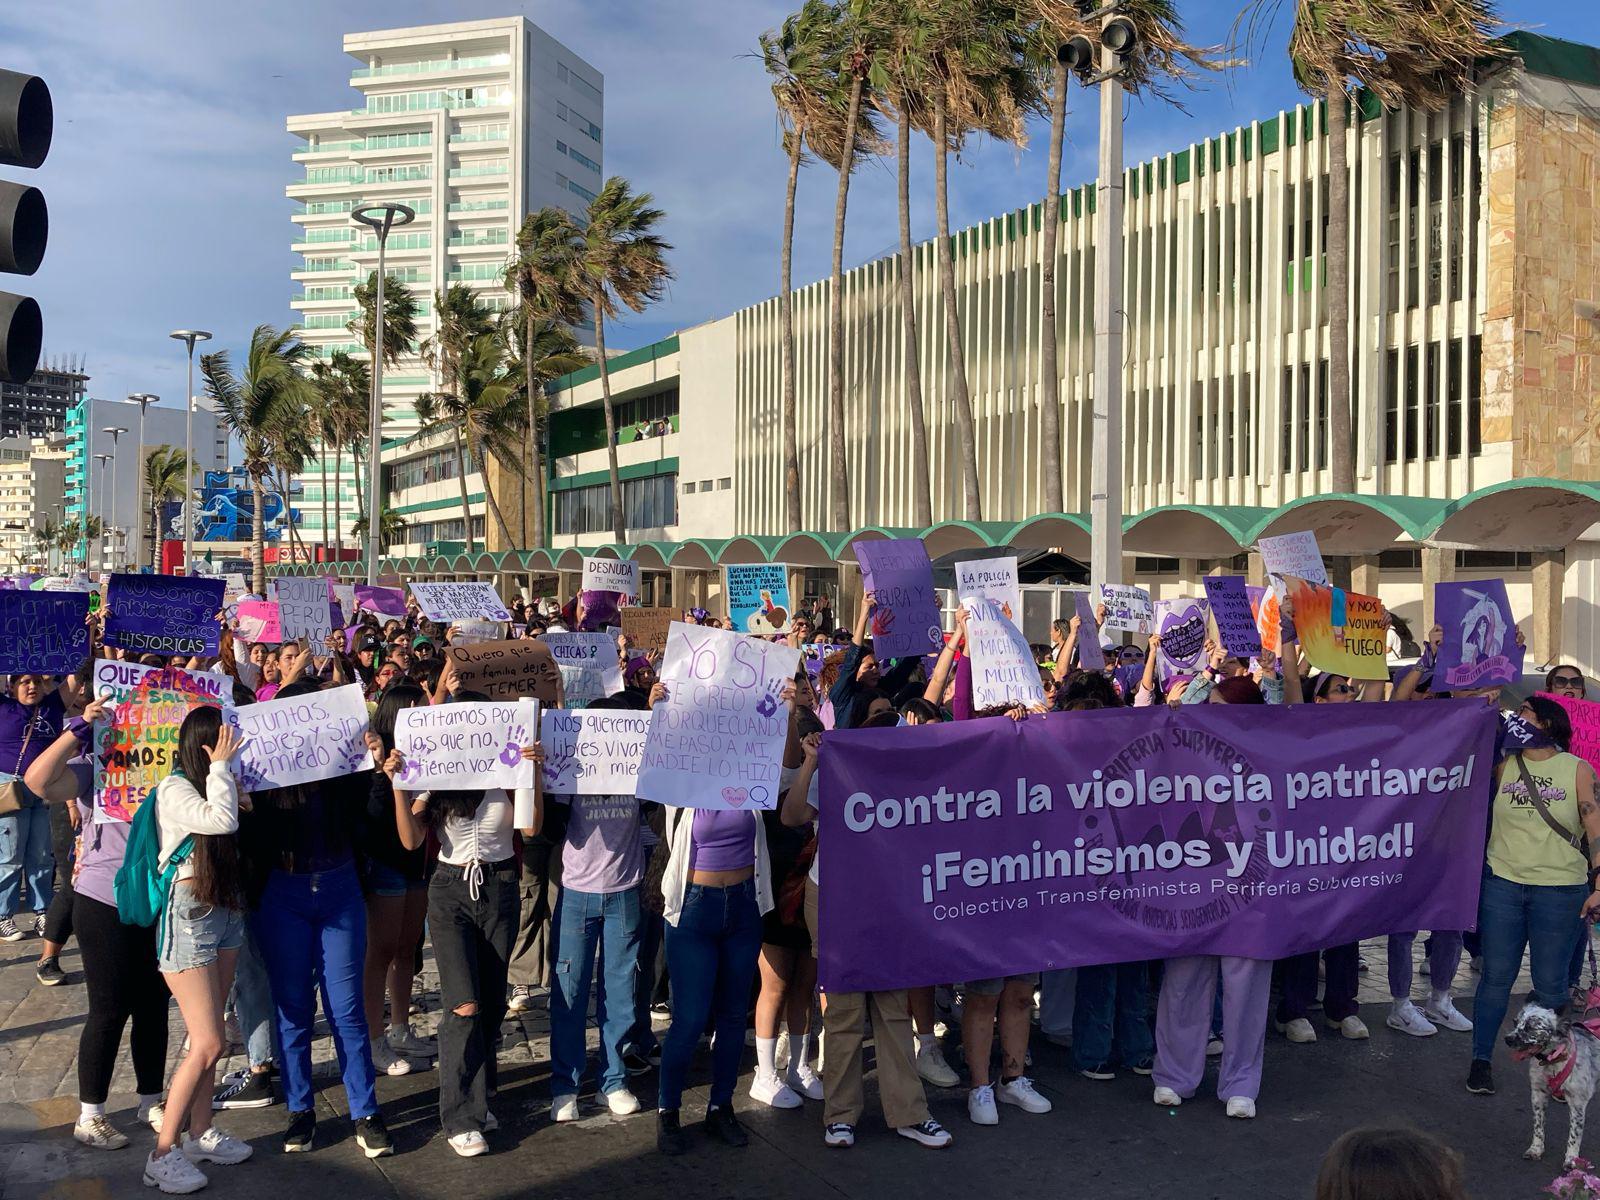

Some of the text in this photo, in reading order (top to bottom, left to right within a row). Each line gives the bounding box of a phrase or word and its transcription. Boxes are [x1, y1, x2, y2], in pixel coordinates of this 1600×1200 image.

[589, 561, 633, 577] DESNUDA
[962, 573, 975, 584] LA
[1100, 583, 1114, 598] Yes
[282, 603, 324, 624] PERO
[1348, 600, 1377, 613] Y NOS
[119, 631, 205, 653] HISTORICAS
[284, 626, 332, 643] NUNCA
[453, 646, 533, 664] Quiero que
[553, 645, 587, 659] CHICAS
[1344, 638, 1383, 656] FUEGO
[98, 664, 140, 686] QUE
[481, 663, 517, 680] familia
[522, 661, 549, 677] deje
[984, 666, 1030, 684] MUJER
[99, 683, 143, 704] QUE
[484, 677, 536, 696] TEMER
[663, 679, 746, 712] TE CREO
[976, 683, 1044, 703] SIN MIEDO
[407, 708, 487, 729] Gritamos
[586, 715, 651, 737] queremos
[97, 726, 141, 747] QUE
[409, 733, 437, 752] las
[440, 732, 465, 752] que
[650, 731, 675, 749] ME
[679, 734, 722, 755] PASO
[726, 739, 738, 755] A
[98, 746, 167, 768] VAMOS
[268, 745, 331, 776] miedo
[645, 752, 780, 782] NADIE LO HIZO
[96, 768, 137, 789] QUE
[416, 758, 466, 778] tienen
[610, 761, 640, 776] mie
[843, 754, 1476, 833] Contra la violencia patriarcal
[921, 837, 1212, 904] ¡Feminismos
[1225, 841, 1254, 878] y
[1265, 822, 1414, 869] Unidad!
[932, 896, 1028, 921] Colectiva
[1037, 879, 1201, 907] Transfeminista
[1210, 878, 1302, 898] Periferia
[1307, 871, 1404, 893] Subversiva
